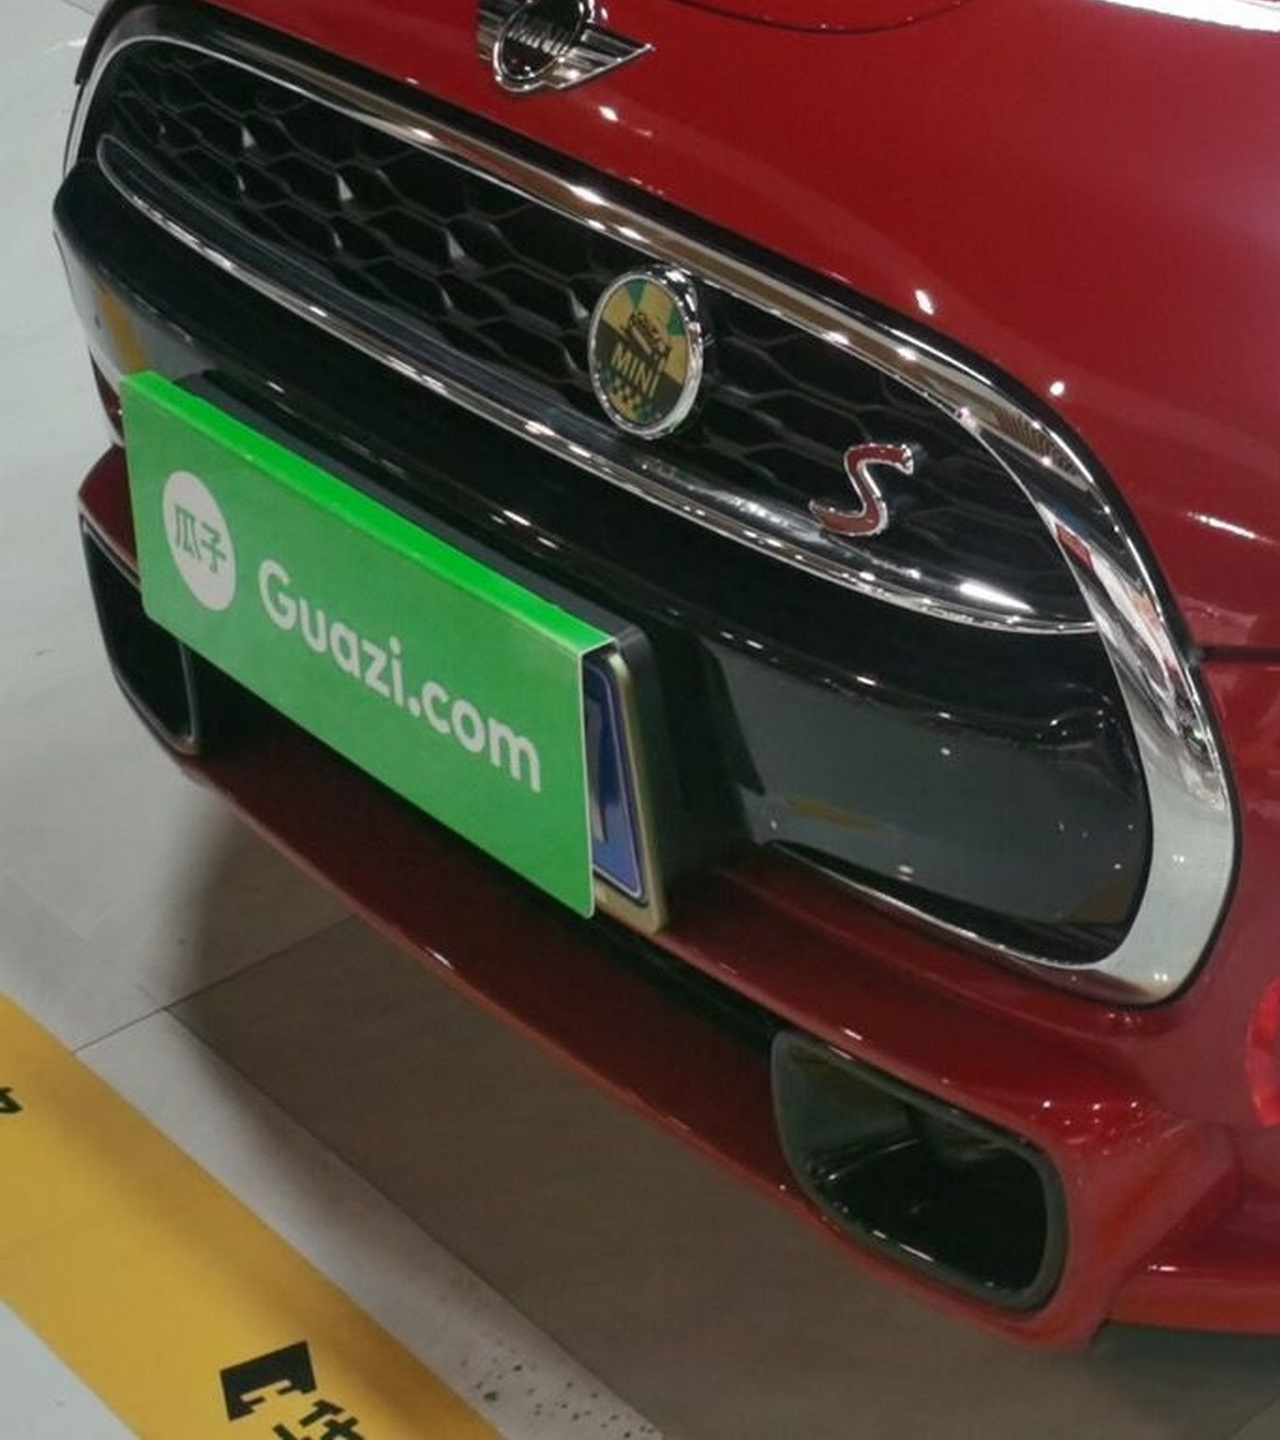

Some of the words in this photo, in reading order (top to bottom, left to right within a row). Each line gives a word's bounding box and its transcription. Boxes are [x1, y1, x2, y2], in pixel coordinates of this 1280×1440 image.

[611, 342, 664, 399] MINI
[809, 441, 914, 536] S
[174, 503, 227, 574] 瓜子
[259, 560, 541, 793] Guazi.com
